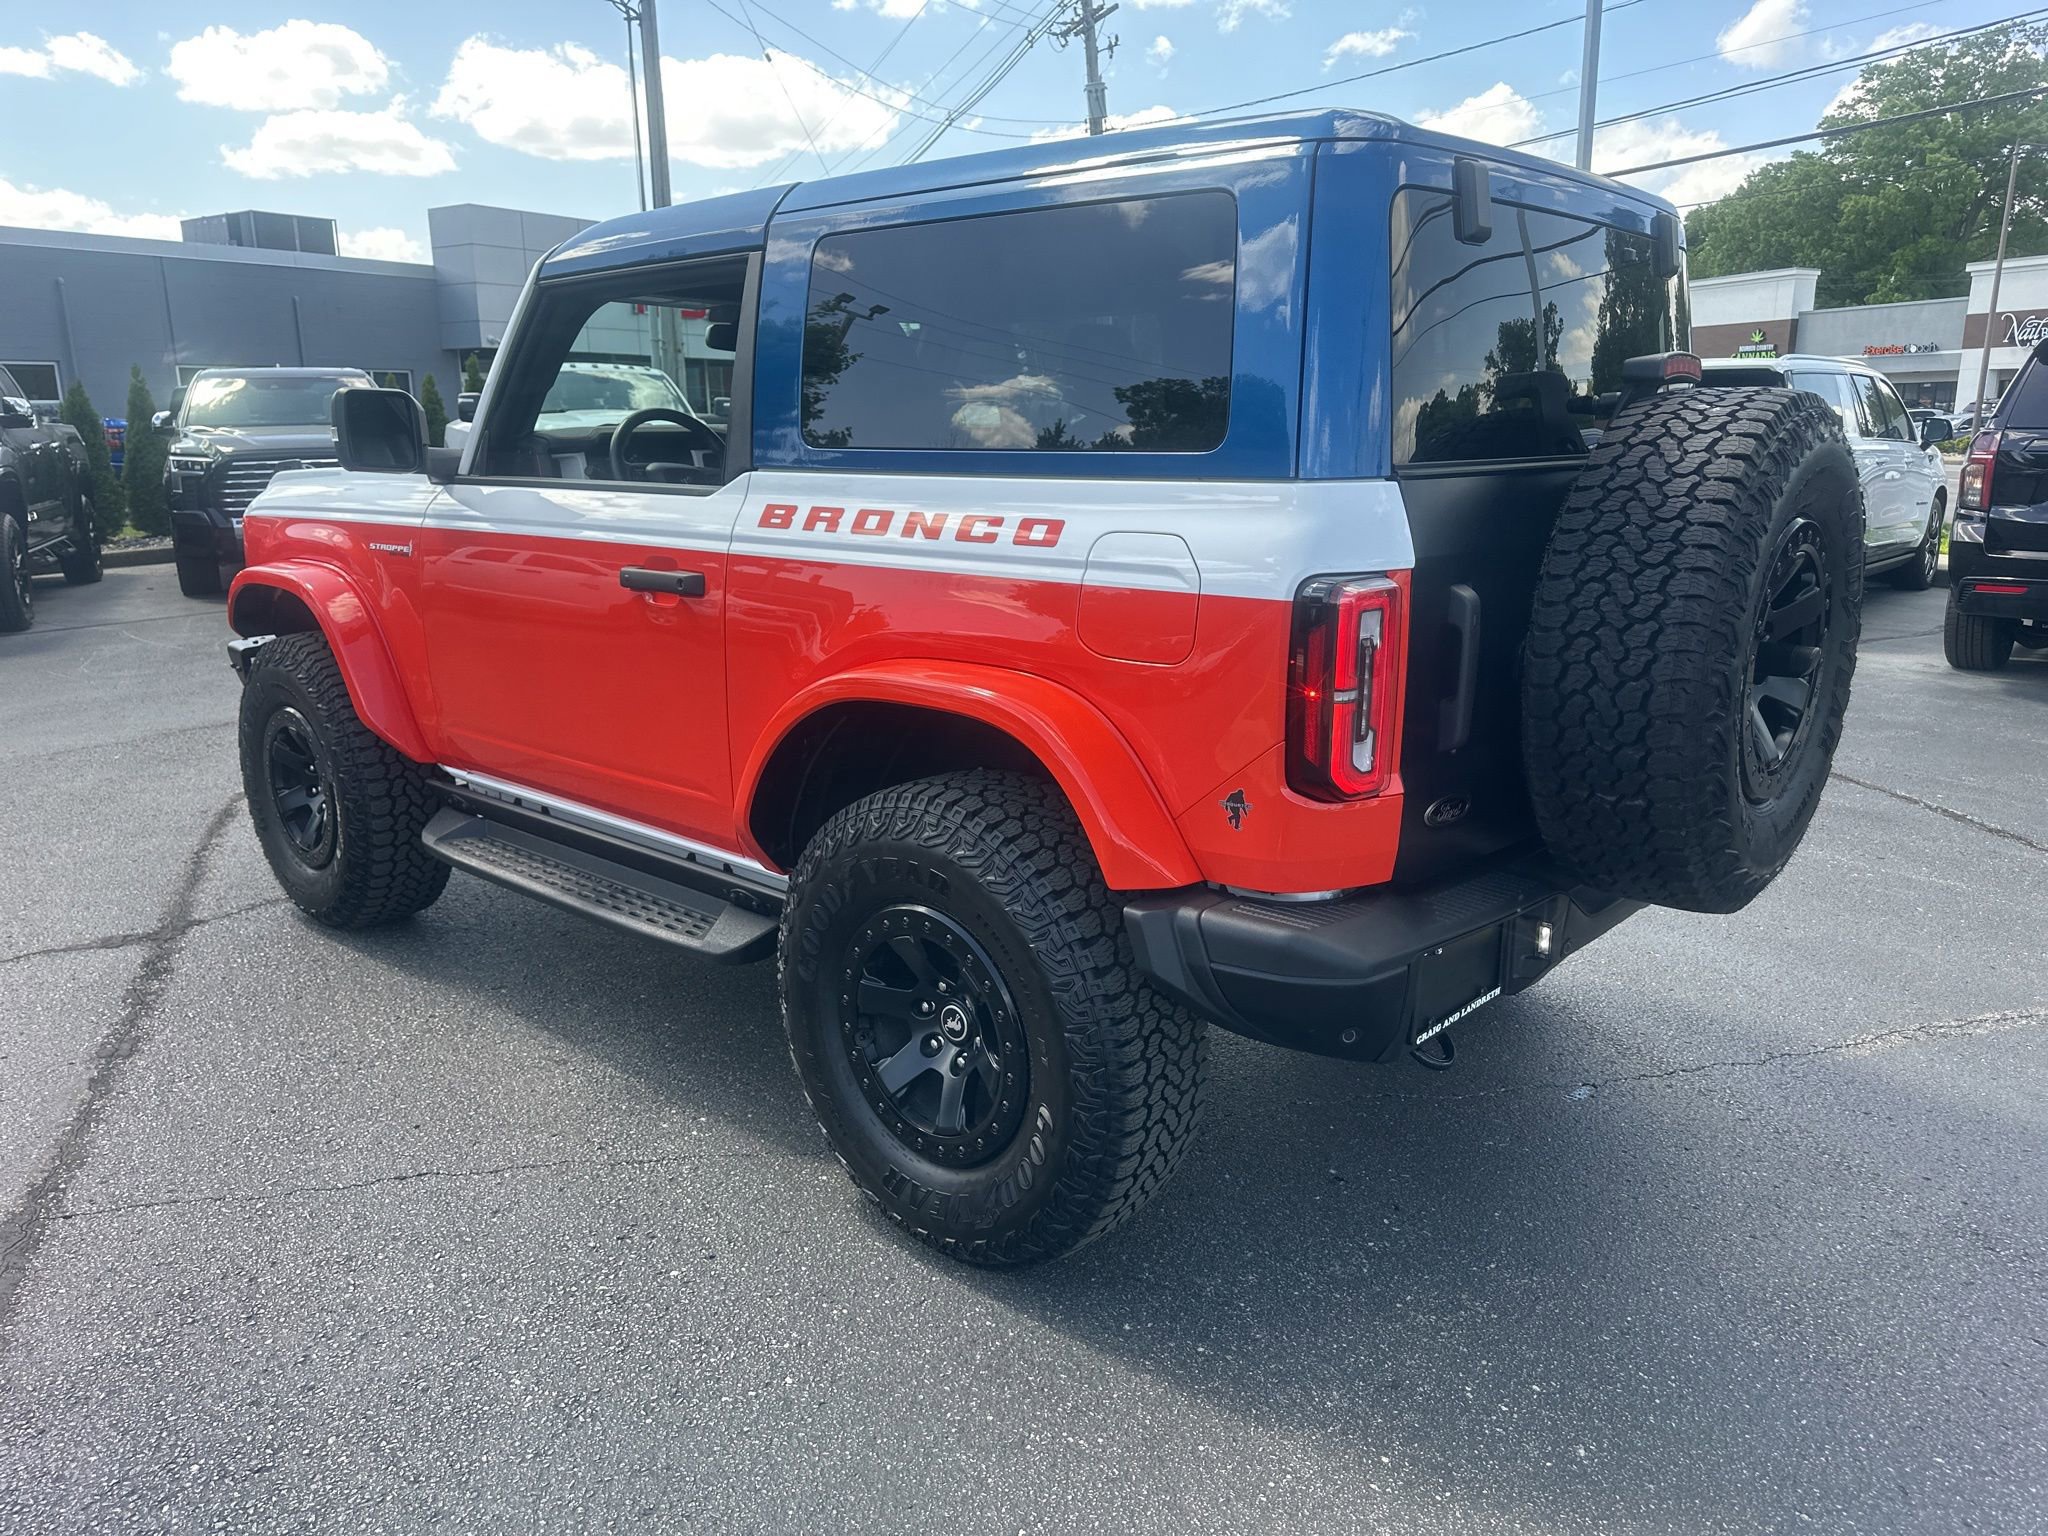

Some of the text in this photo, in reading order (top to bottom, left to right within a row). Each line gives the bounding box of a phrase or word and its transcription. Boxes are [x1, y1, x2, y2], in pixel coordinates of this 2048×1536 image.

[2001, 313, 2045, 349] Nail
[369, 543, 410, 553] STROPPE
[757, 503, 1065, 547] BRONCO
[797, 855, 951, 983] GOODYEAR
[1416, 986, 1501, 1045] CRAIG AND LANDRETH
[882, 1103, 1053, 1222] GOODYEAR
